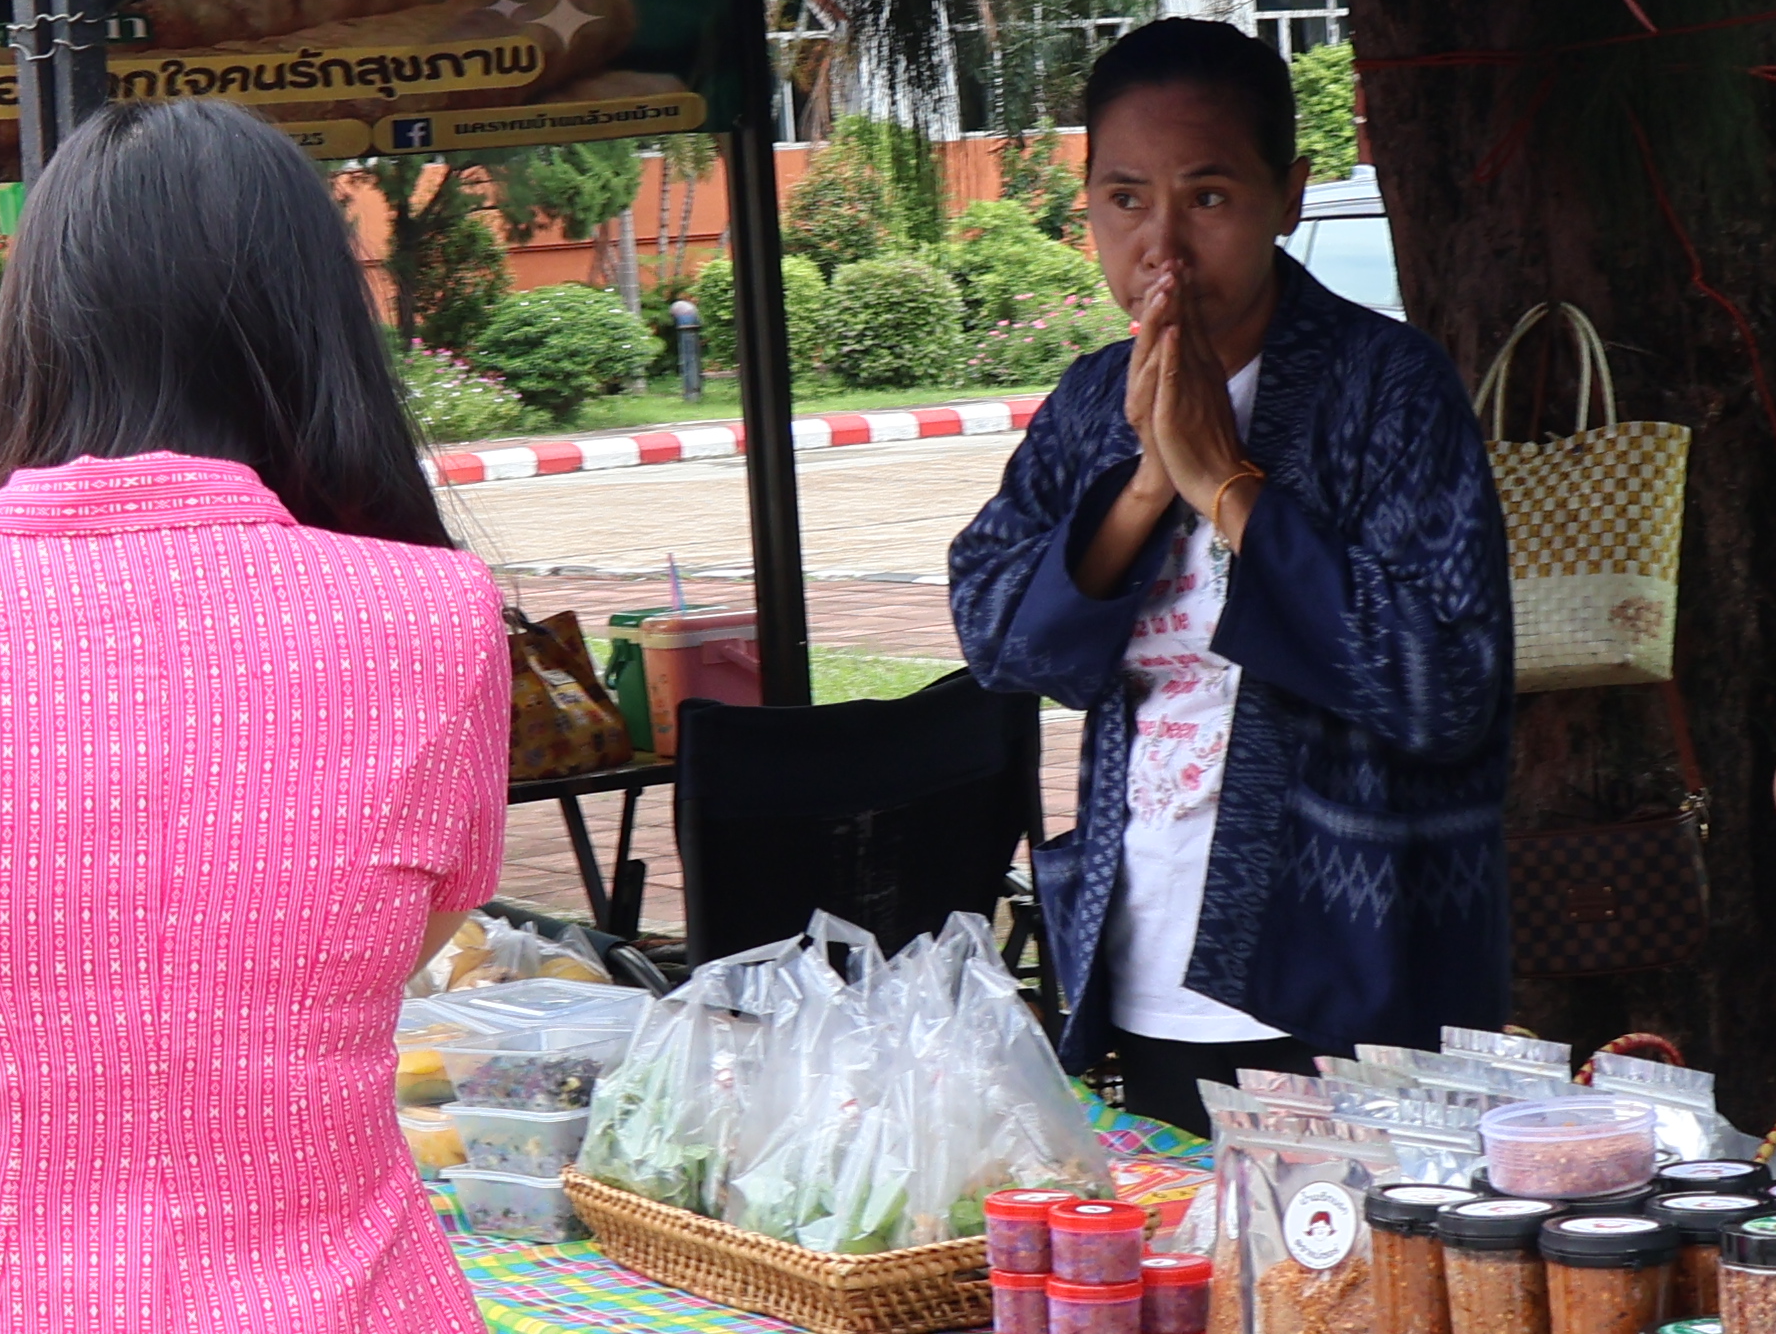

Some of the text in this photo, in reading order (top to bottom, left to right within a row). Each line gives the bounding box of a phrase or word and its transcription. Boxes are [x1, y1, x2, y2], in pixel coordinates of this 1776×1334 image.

[106, 43, 539, 99] กใจคนรักสุขภาพ
